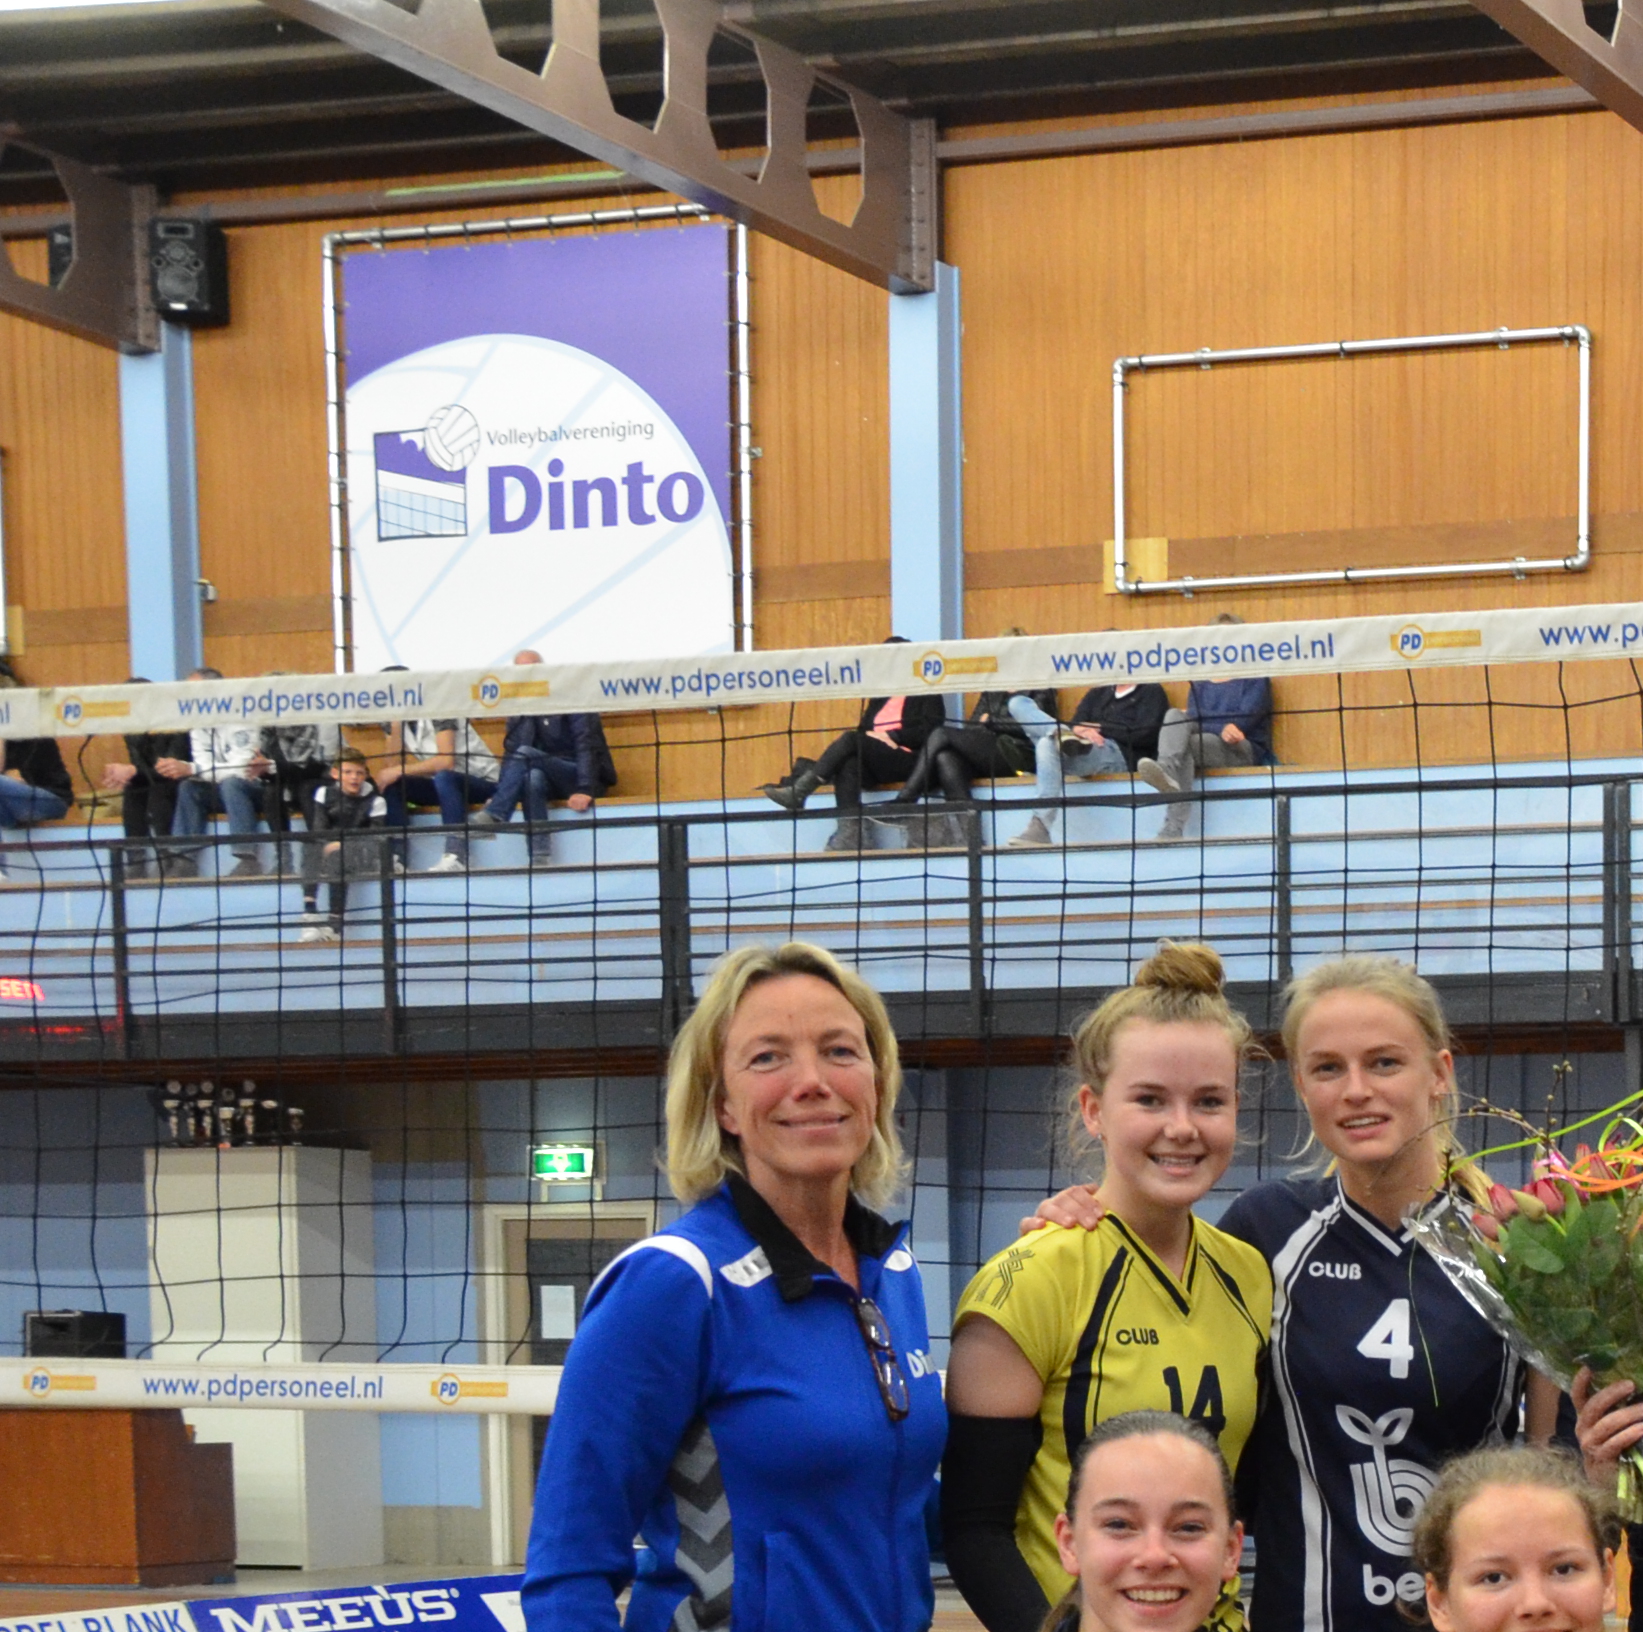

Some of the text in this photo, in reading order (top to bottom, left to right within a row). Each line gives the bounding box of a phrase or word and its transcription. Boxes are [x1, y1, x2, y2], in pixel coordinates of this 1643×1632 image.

[487, 420, 654, 448] Volleybalvereniging
[488, 458, 704, 534] Dinto
[1052, 634, 1335, 674] www.pdpersoneel.nl
[1400, 633, 1422, 651] PD
[601, 661, 862, 698] www.pdpersoneel.nl
[923, 659, 943, 677] PD
[178, 689, 423, 716] www.pdpersoneel.nl
[1308, 1260, 1362, 1281] CLUB
[1115, 1327, 1159, 1346] CLUB
[1356, 1298, 1414, 1379] 4
[144, 1374, 384, 1401] www.pdpersoneel.nl
[440, 1382, 457, 1397] PD
[1162, 1365, 1226, 1440] 14
